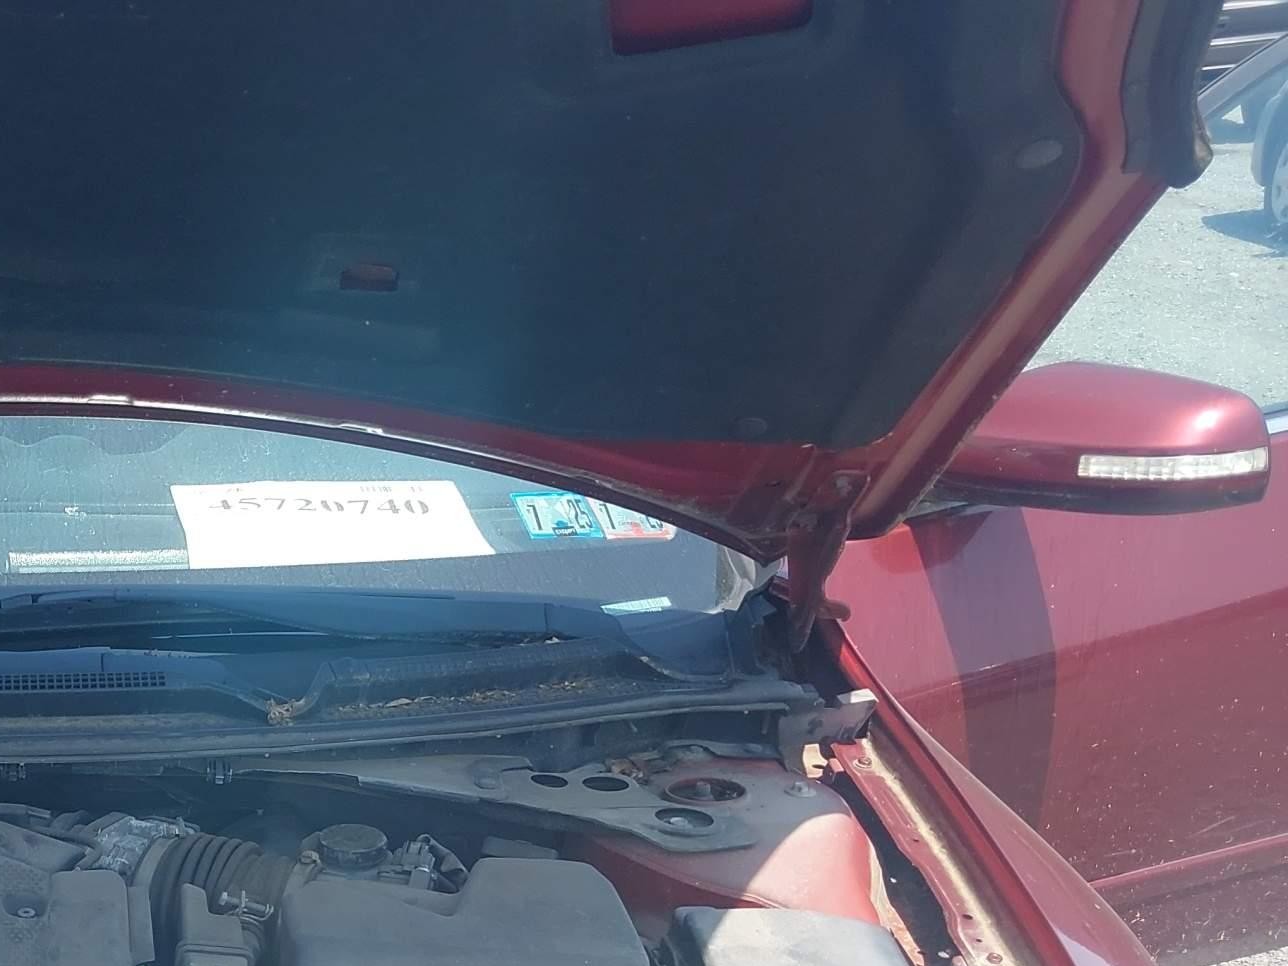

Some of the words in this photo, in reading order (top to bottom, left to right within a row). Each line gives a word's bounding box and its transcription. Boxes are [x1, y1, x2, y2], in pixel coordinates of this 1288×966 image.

[209, 497, 429, 514] 45720740
[527, 504, 543, 530] 7
[567, 499, 593, 529] 25
[599, 503, 617, 530] 7
